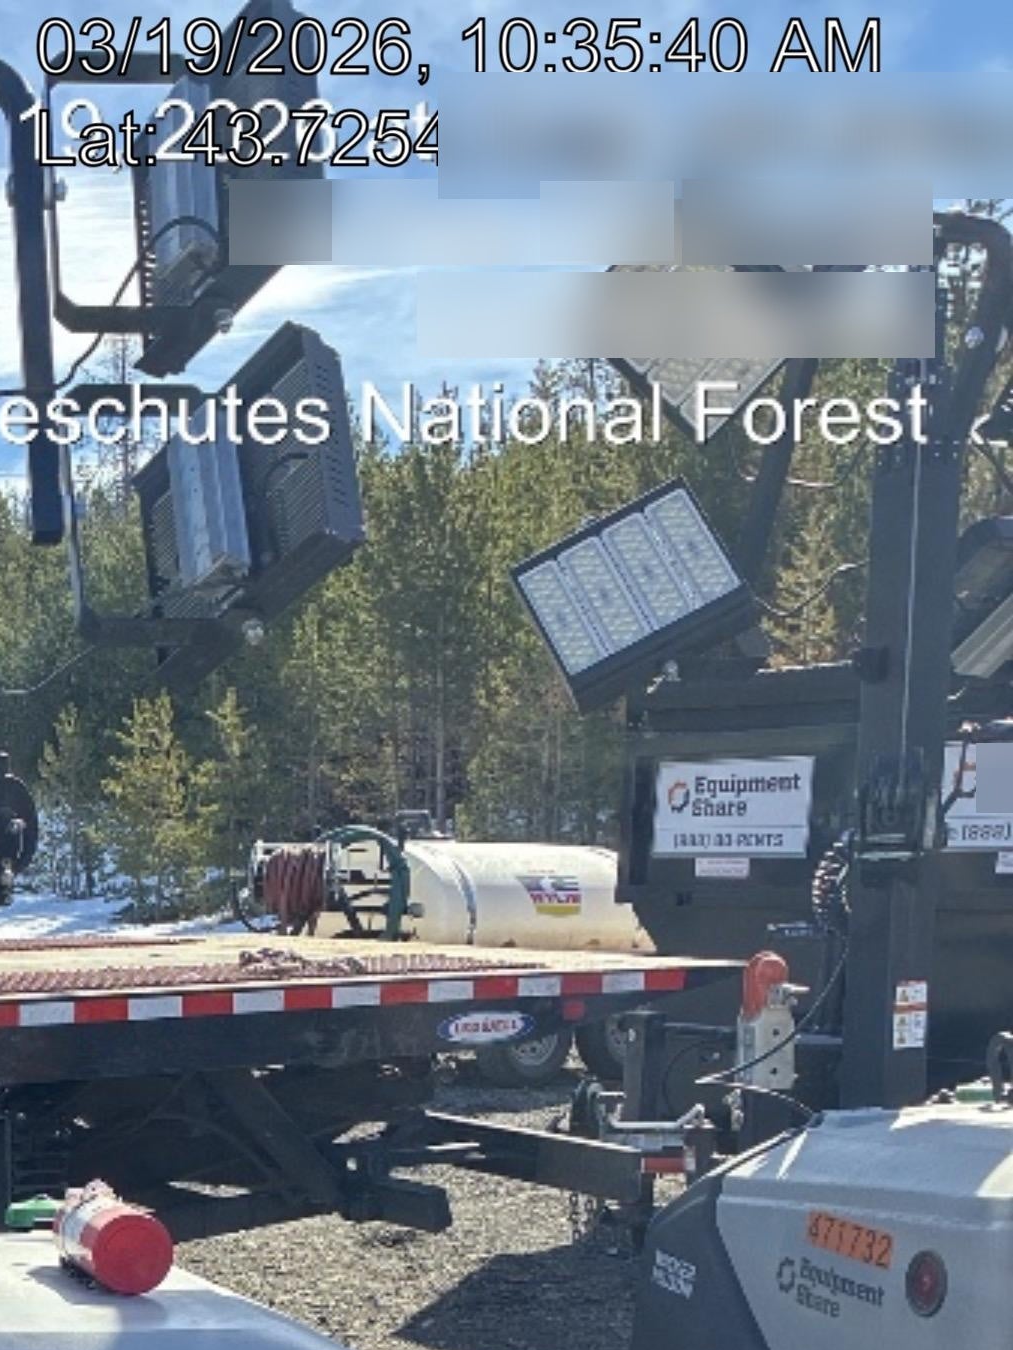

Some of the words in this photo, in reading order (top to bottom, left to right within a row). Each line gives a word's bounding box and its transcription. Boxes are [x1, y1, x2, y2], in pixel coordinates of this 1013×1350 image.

[694, 774, 801, 798] Equipment
[691, 799, 748, 817] Share
[800, 1256, 885, 1307] Equipment
[796, 1283, 841, 1318] Share
